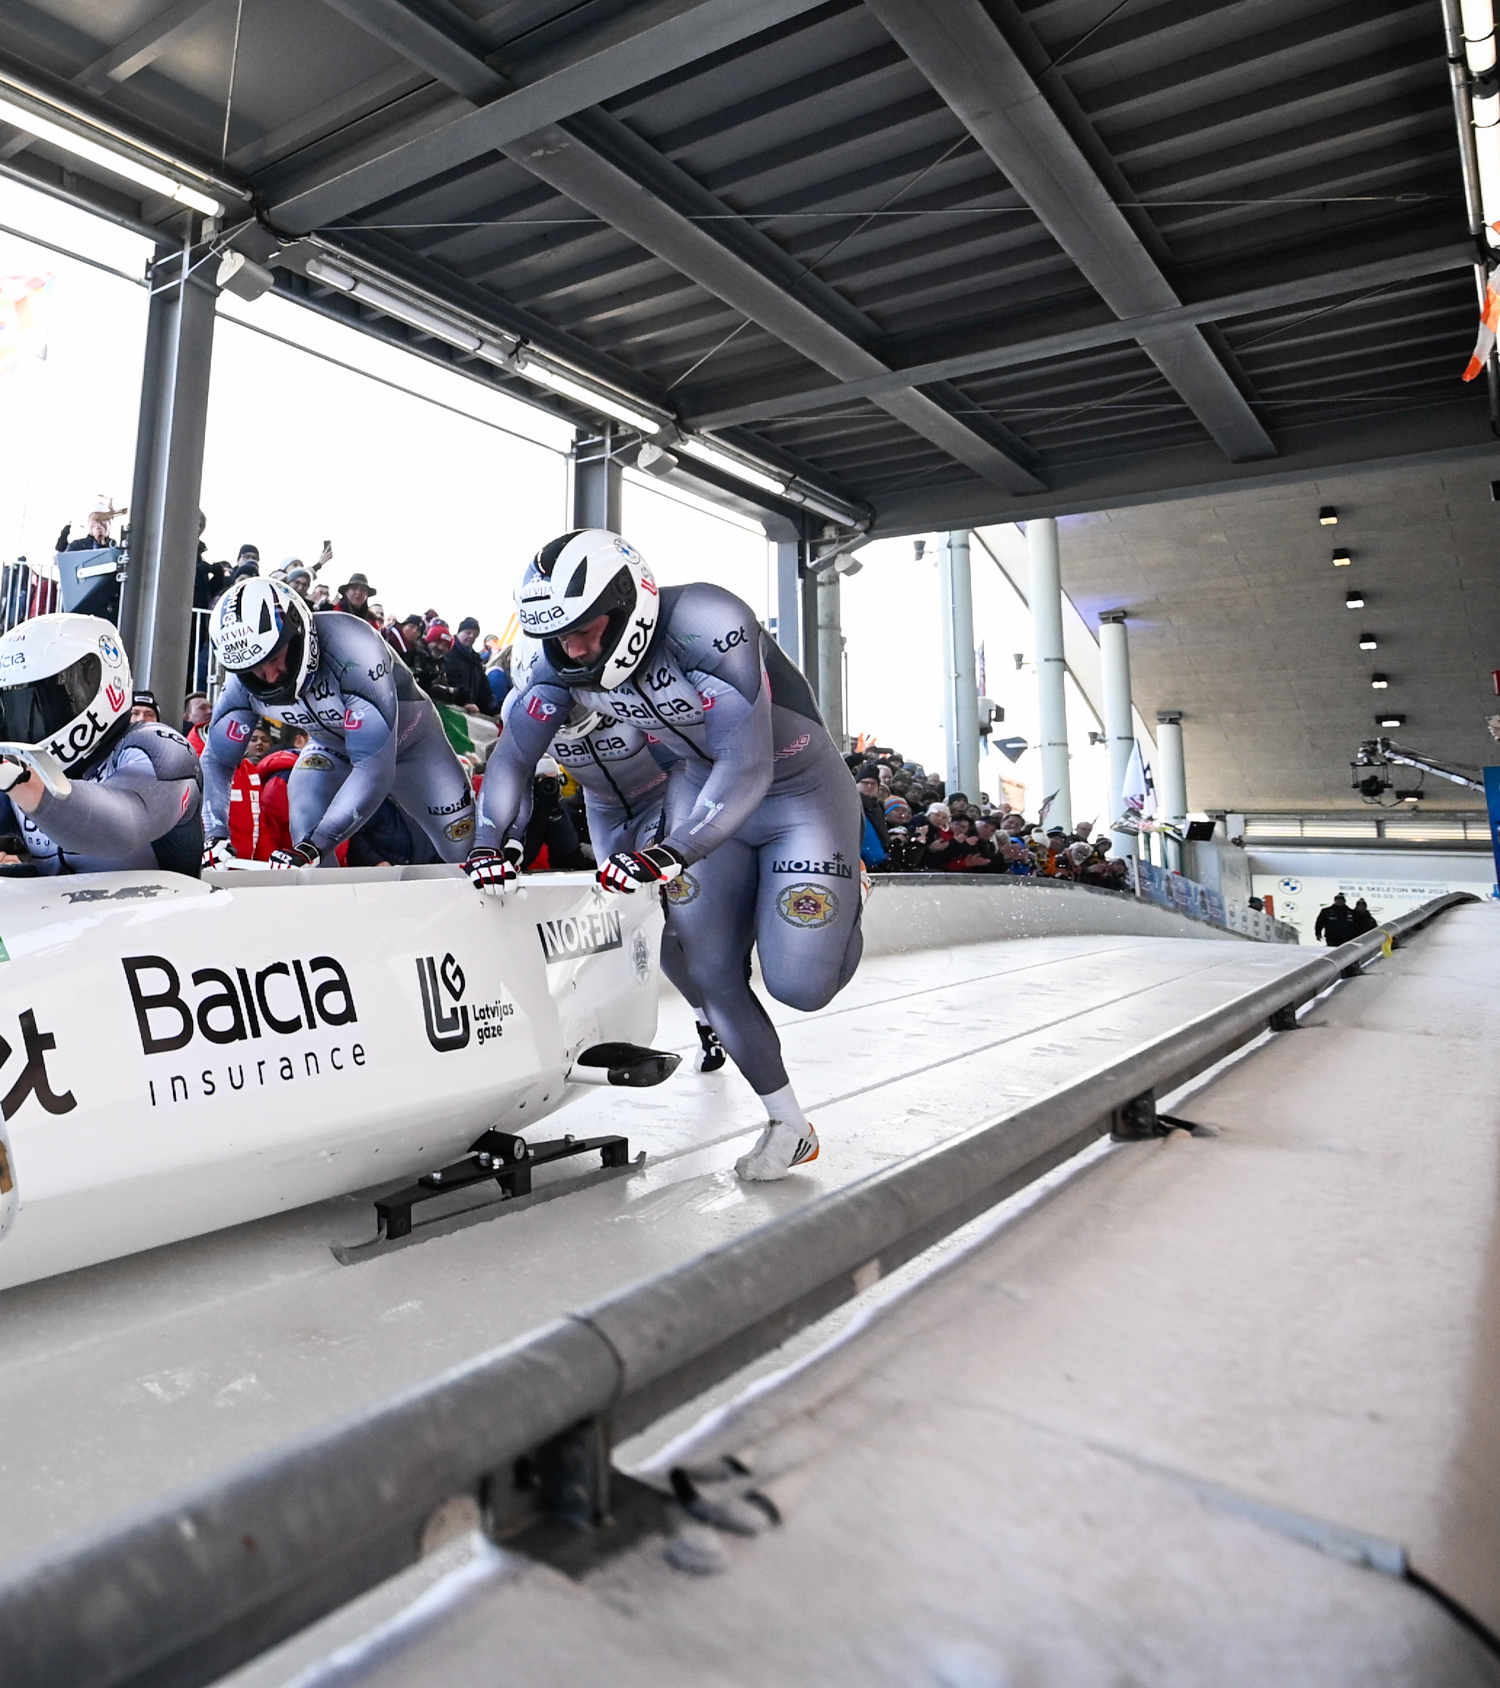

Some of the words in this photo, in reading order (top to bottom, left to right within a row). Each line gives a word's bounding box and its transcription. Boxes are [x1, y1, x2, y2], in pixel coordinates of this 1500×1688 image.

[519, 605, 565, 625] Balcia
[223, 638, 249, 653] BMW
[614, 617, 654, 669] tet
[712, 626, 749, 654] tet
[222, 643, 263, 664] Balcia
[281, 708, 344, 724] Balcia
[610, 698, 695, 719] Balcia
[51, 710, 108, 763] tet
[554, 736, 627, 758] Balcia
[271, 850, 293, 863] SEIZ
[615, 851, 641, 875] SEIZ
[772, 860, 853, 879] NORFIN
[542, 909, 621, 957] NORFIN
[122, 955, 358, 1056] Balcia
[472, 1000, 514, 1022] Latvijas
[477, 1021, 503, 1045] gāze
[148, 1043, 368, 1107] insurance
